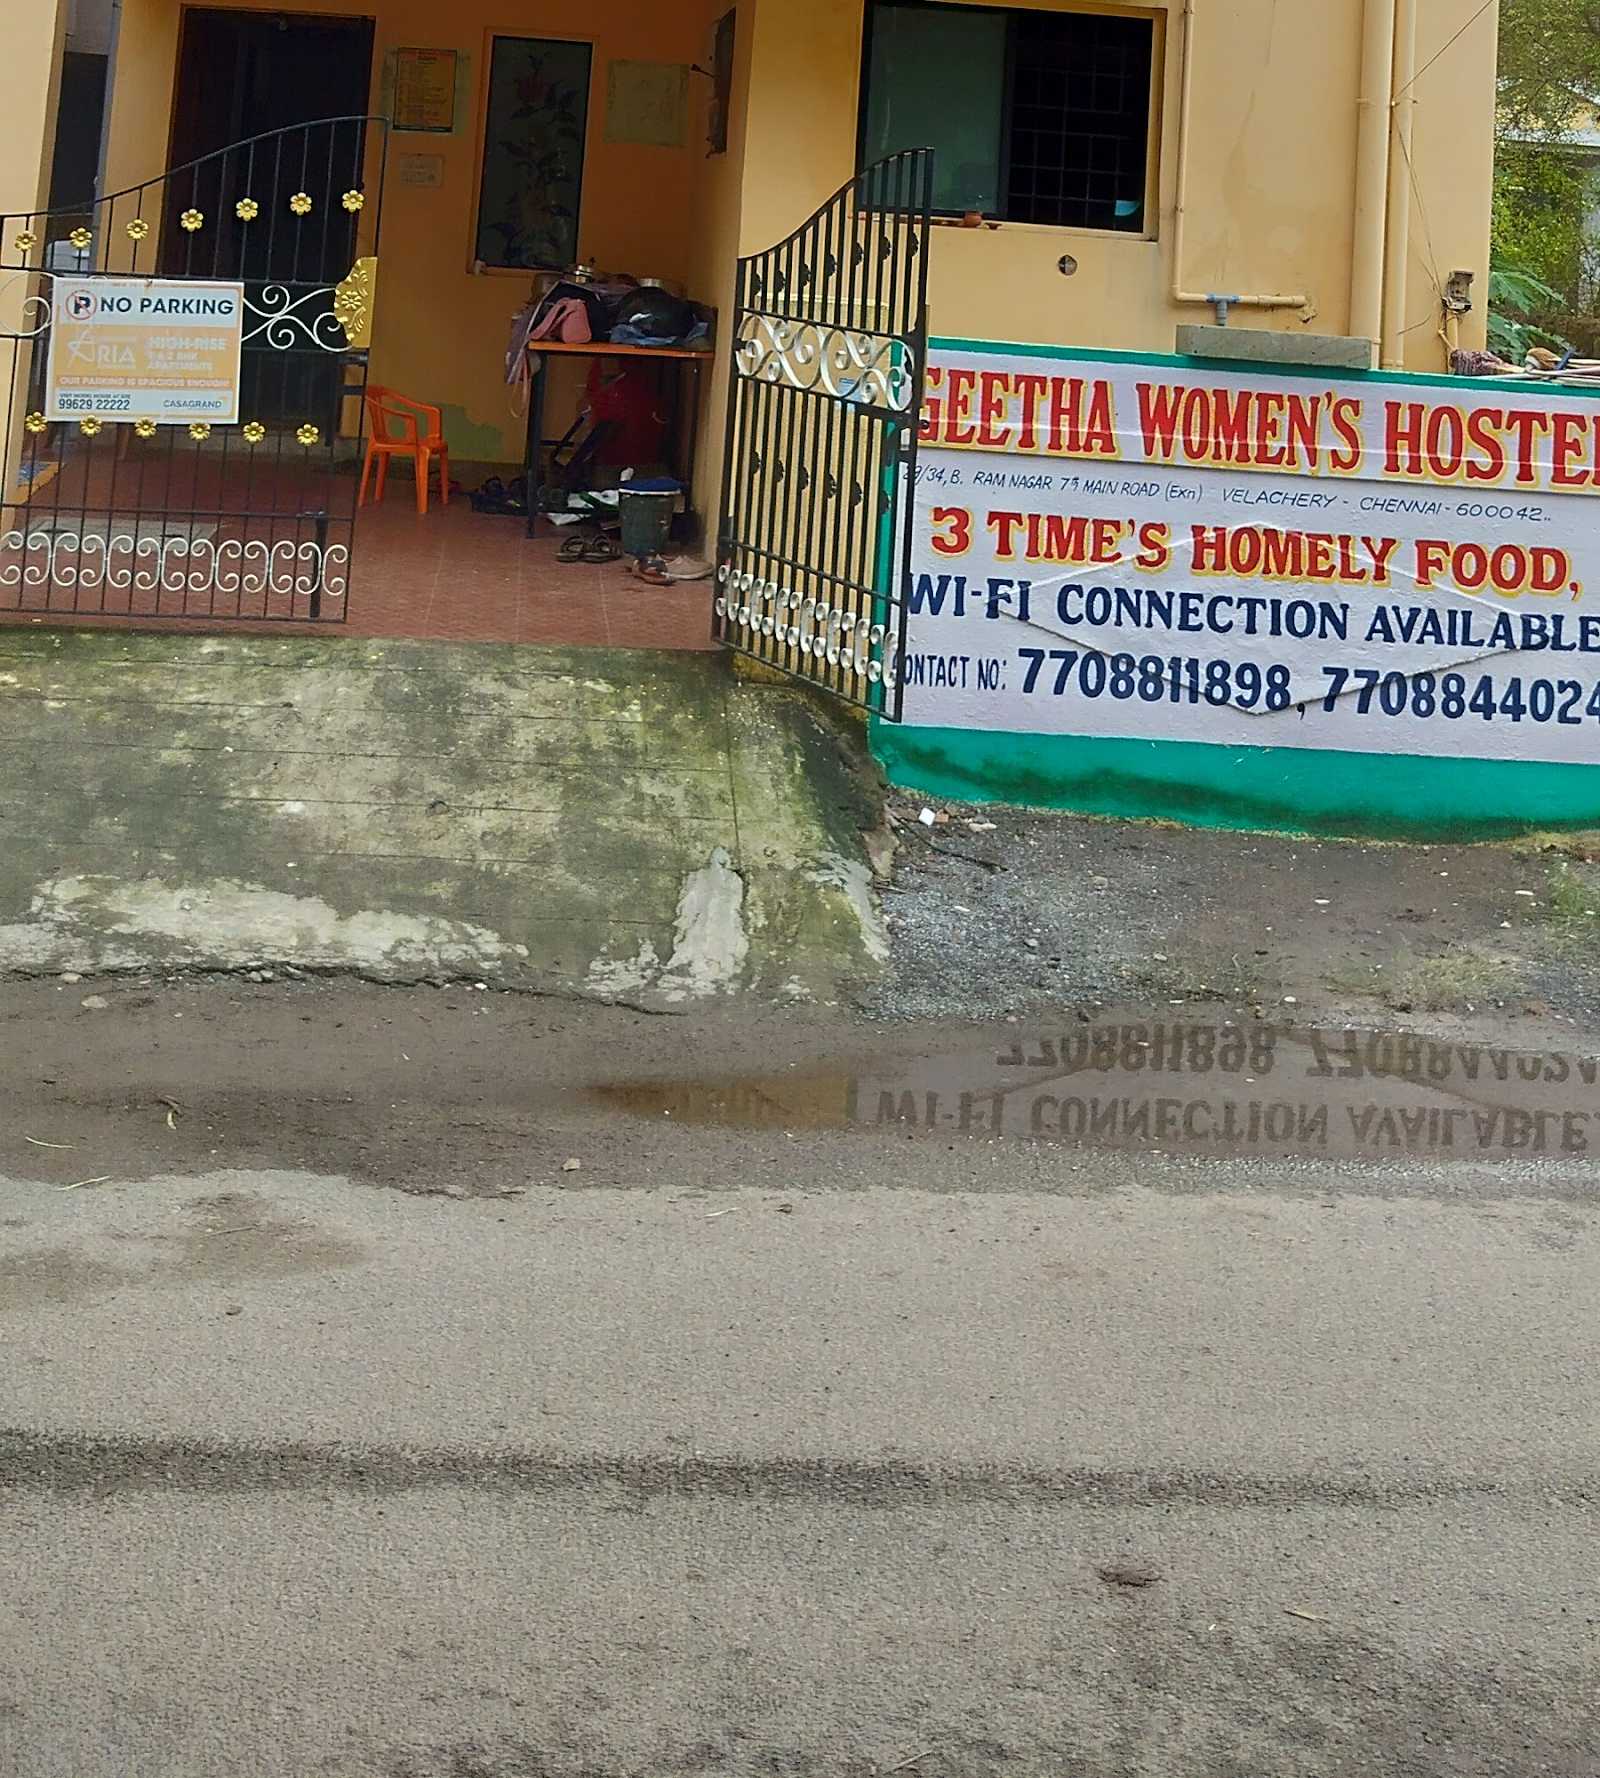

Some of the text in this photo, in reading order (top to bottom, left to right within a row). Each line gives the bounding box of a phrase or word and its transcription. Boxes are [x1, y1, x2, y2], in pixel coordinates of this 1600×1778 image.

[100, 297, 234, 315] NO PARKING
[148, 336, 227, 351] HIGH-RISE
[60, 377, 80, 385] OUR
[81, 378, 125, 386] PARKING
[138, 378, 186, 387] SPACIOUS
[59, 399, 222, 410] 99629 22222 CASAGRAND
[1135, 380, 1364, 478] WOMEN'S
[1381, 399, 1600, 494] HOSTE
[972, 470, 1007, 487] RAM
[1009, 473, 1054, 491] NAGAR
[1082, 478, 1119, 496] MAIN
[1119, 480, 1161, 498] ROAD
[1164, 479, 1204, 503] (Exn)
[1222, 486, 1338, 509] VELACHERY
[930, 505, 1582, 602] 3 TIME'S HOMELY FOOD,
[908, 572, 1600, 653] WI-FI CONNECTION AVAILABLE
[893, 653, 970, 688] ONTACT
[977, 657, 1008, 691] NO:
[1320, 666, 1600, 725] 7708844024
